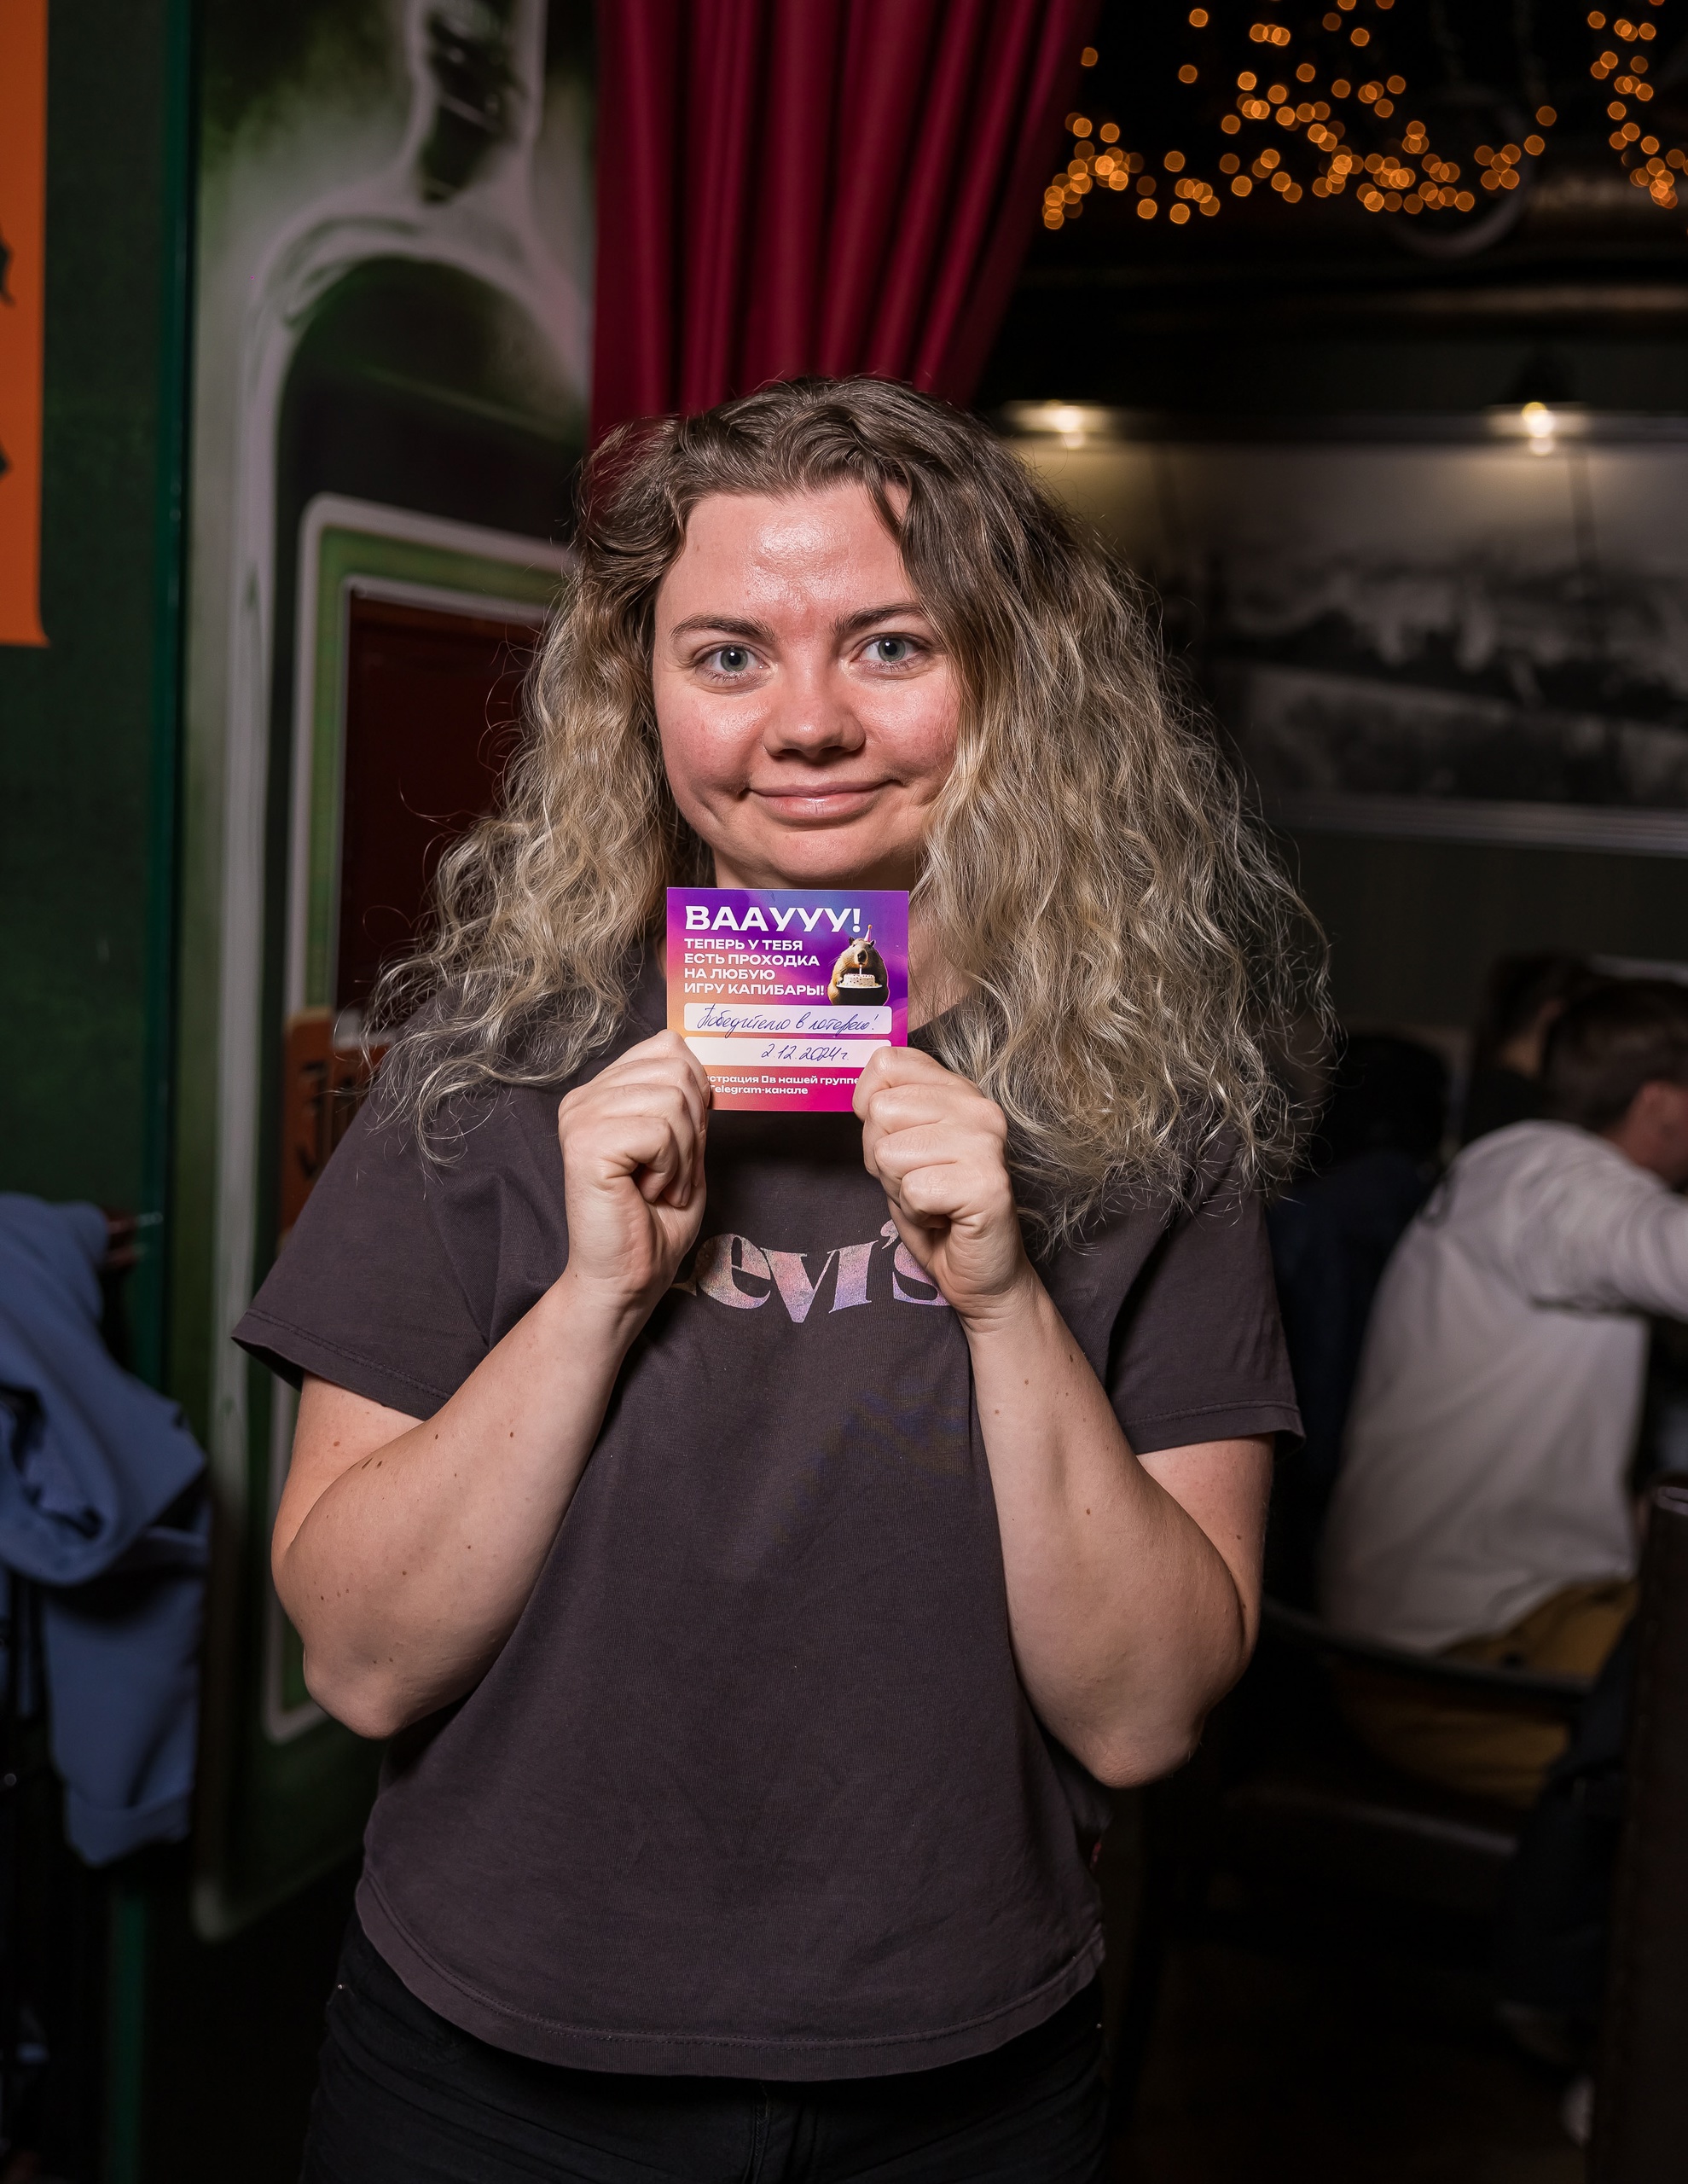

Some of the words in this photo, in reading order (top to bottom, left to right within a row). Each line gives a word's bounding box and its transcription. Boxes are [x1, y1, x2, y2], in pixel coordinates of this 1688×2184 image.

[685, 905, 861, 933] ВААУУУ!
[684, 938, 745, 950] ТЕПЕРЬ
[747, 939, 761, 951] У
[762, 940, 803, 951] ТЕБЯ
[684, 953, 726, 965] ЕСТЬ
[728, 954, 820, 967] ПРОХОДКА
[684, 968, 708, 979] НА
[711, 968, 776, 980] ЛЮБУЮ
[684, 983, 726, 996] ИГРУ
[728, 985, 825, 996] КАПИБАРЫ!
[707, 1075, 759, 1084] страция
[778, 1076, 818, 1084] нашей
